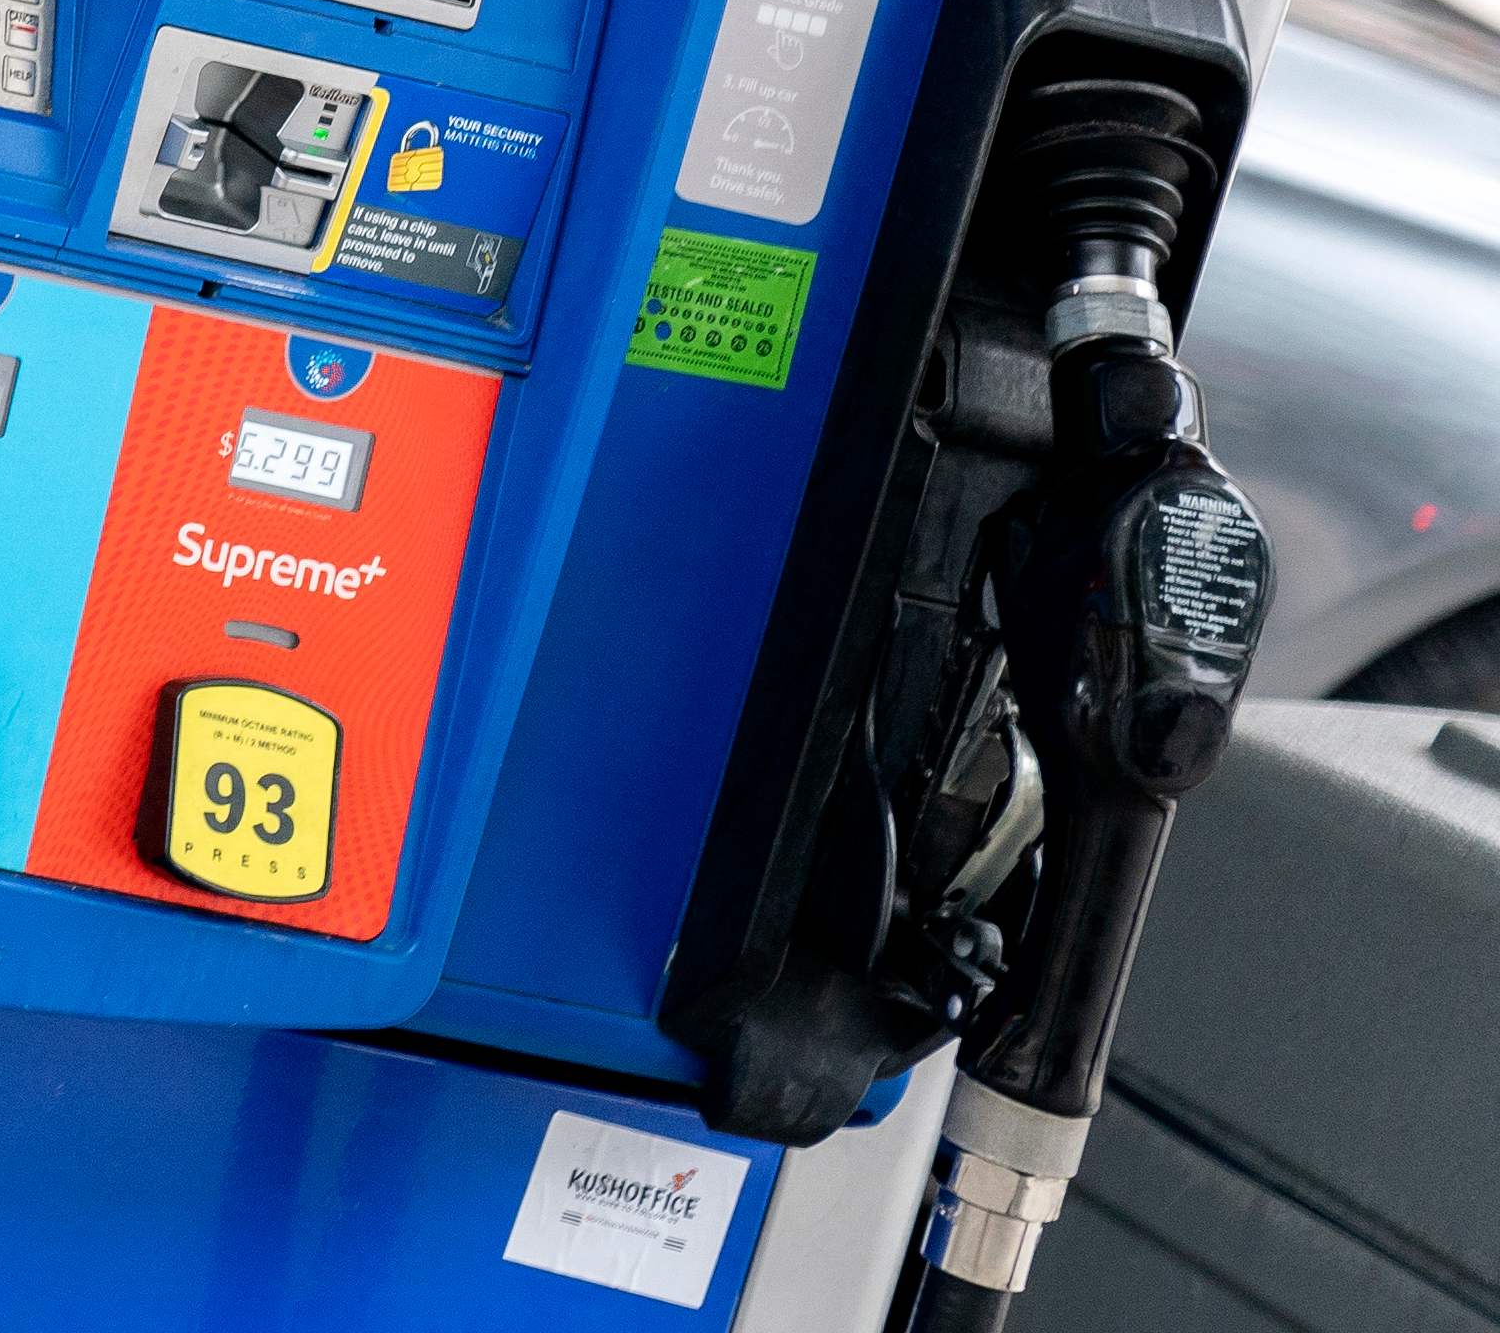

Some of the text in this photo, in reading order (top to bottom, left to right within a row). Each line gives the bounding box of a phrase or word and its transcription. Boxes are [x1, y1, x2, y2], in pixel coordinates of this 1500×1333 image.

[235, 432, 345, 489] 6.299
[172, 523, 388, 602] Supreme+
[202, 761, 298, 846] 93
[567, 1168, 700, 1220] KUSHOFFICE
